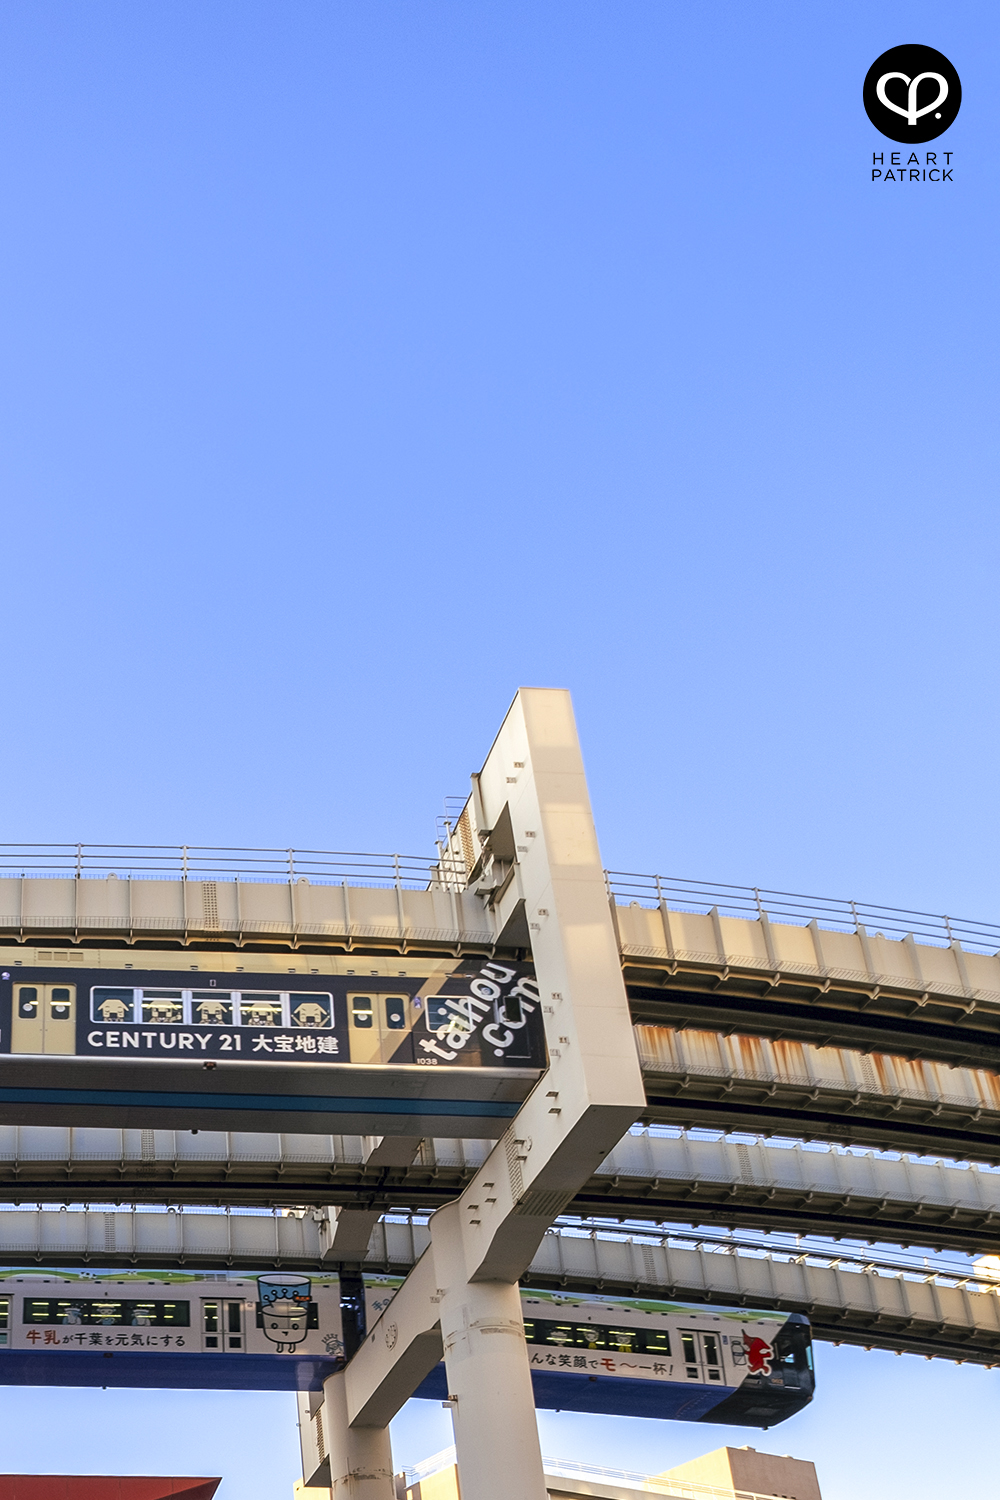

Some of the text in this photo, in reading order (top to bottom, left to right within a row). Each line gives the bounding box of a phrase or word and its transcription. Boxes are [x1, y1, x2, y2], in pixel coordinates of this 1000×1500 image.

[419, 963, 516, 1060] taihou
[87, 1031, 339, 1054] CENTURY 21 大宝地建
[26, 1330, 186, 1347] 牛乳が千葉を元気にする
